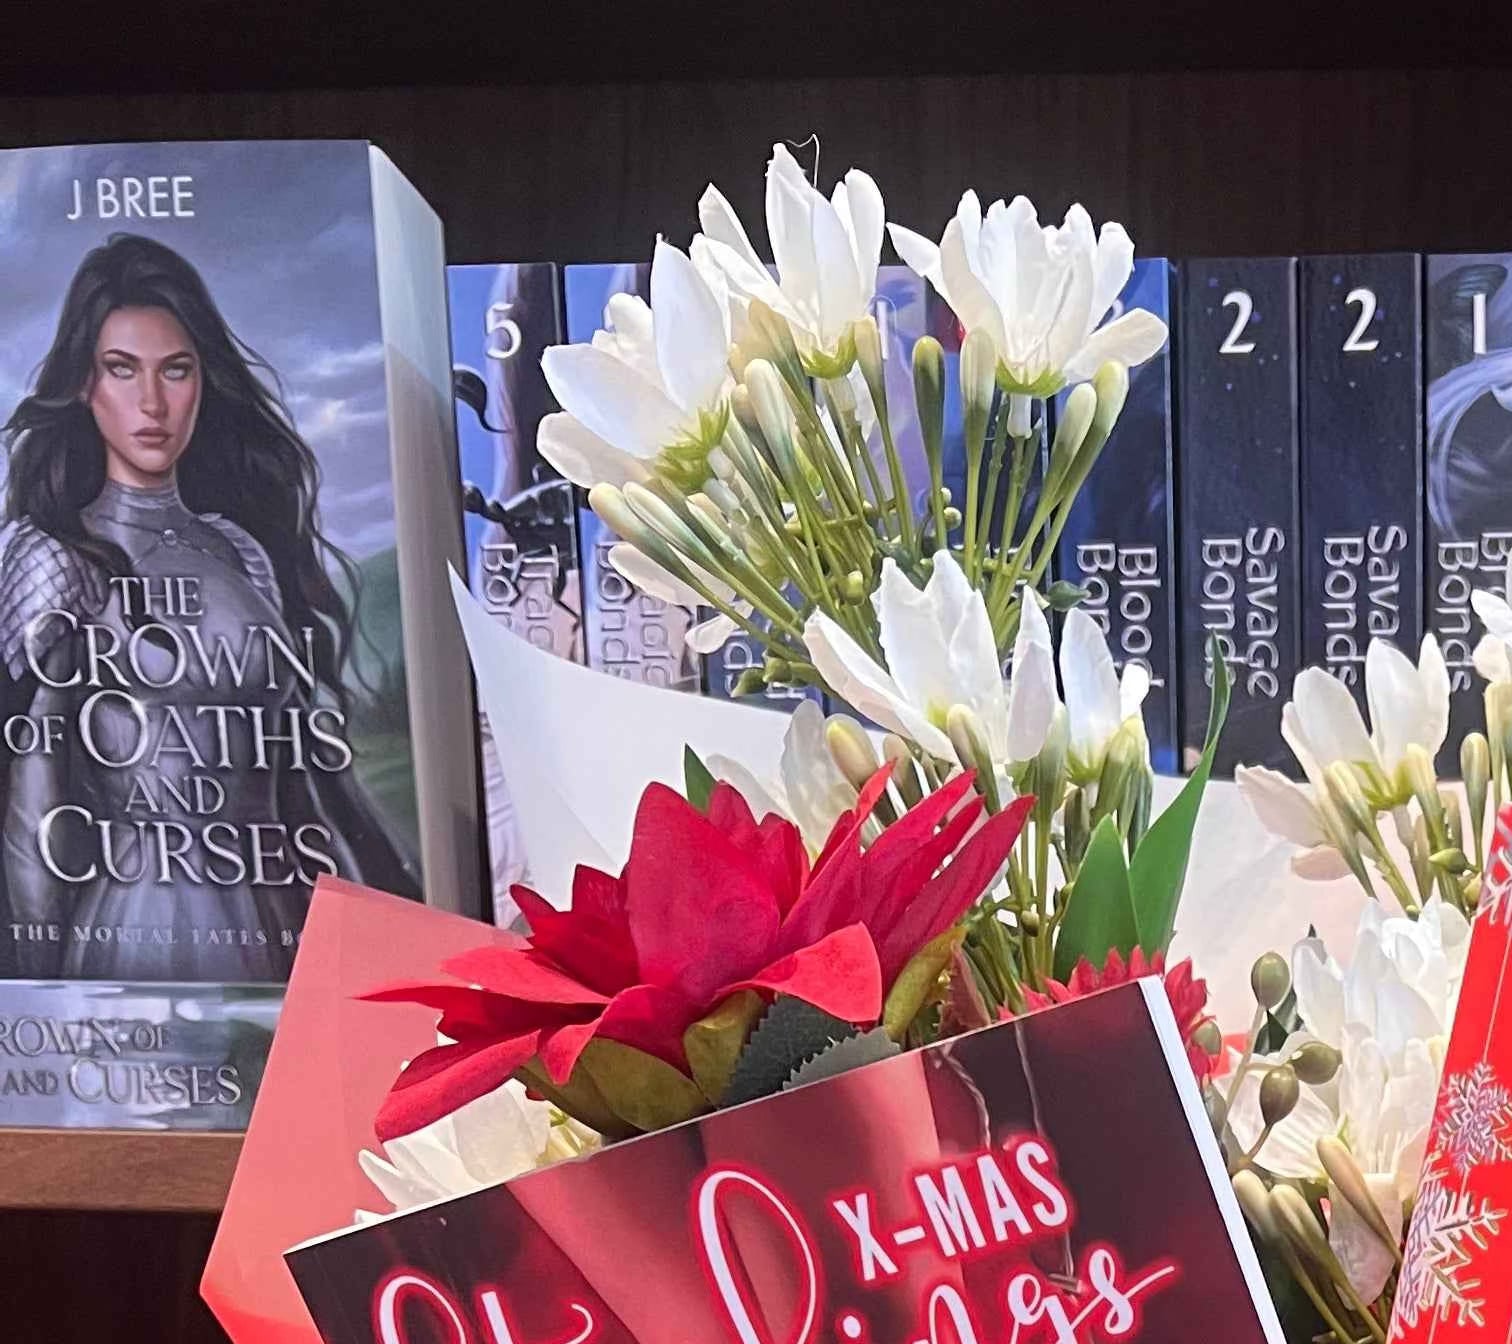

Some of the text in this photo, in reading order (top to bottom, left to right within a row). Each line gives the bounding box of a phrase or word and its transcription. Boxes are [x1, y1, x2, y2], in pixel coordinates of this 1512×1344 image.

[67, 176, 195, 219] J BREE
[485, 303, 522, 359] 5
[1218, 289, 1256, 354] 2
[1343, 288, 1380, 352] 2
[110, 576, 204, 616] THE
[1245, 526, 1286, 698] Savage
[1436, 541, 1480, 692] Bonds
[24, 609, 315, 688] CROWN
[4, 690, 352, 771] OF OATHS
[125, 775, 226, 814] AND
[37, 805, 338, 886] CURSES
[9, 924, 60, 942] THE
[68, 1056, 241, 1105] CURSES
[834, 1140, 1069, 1282] X-MAS
